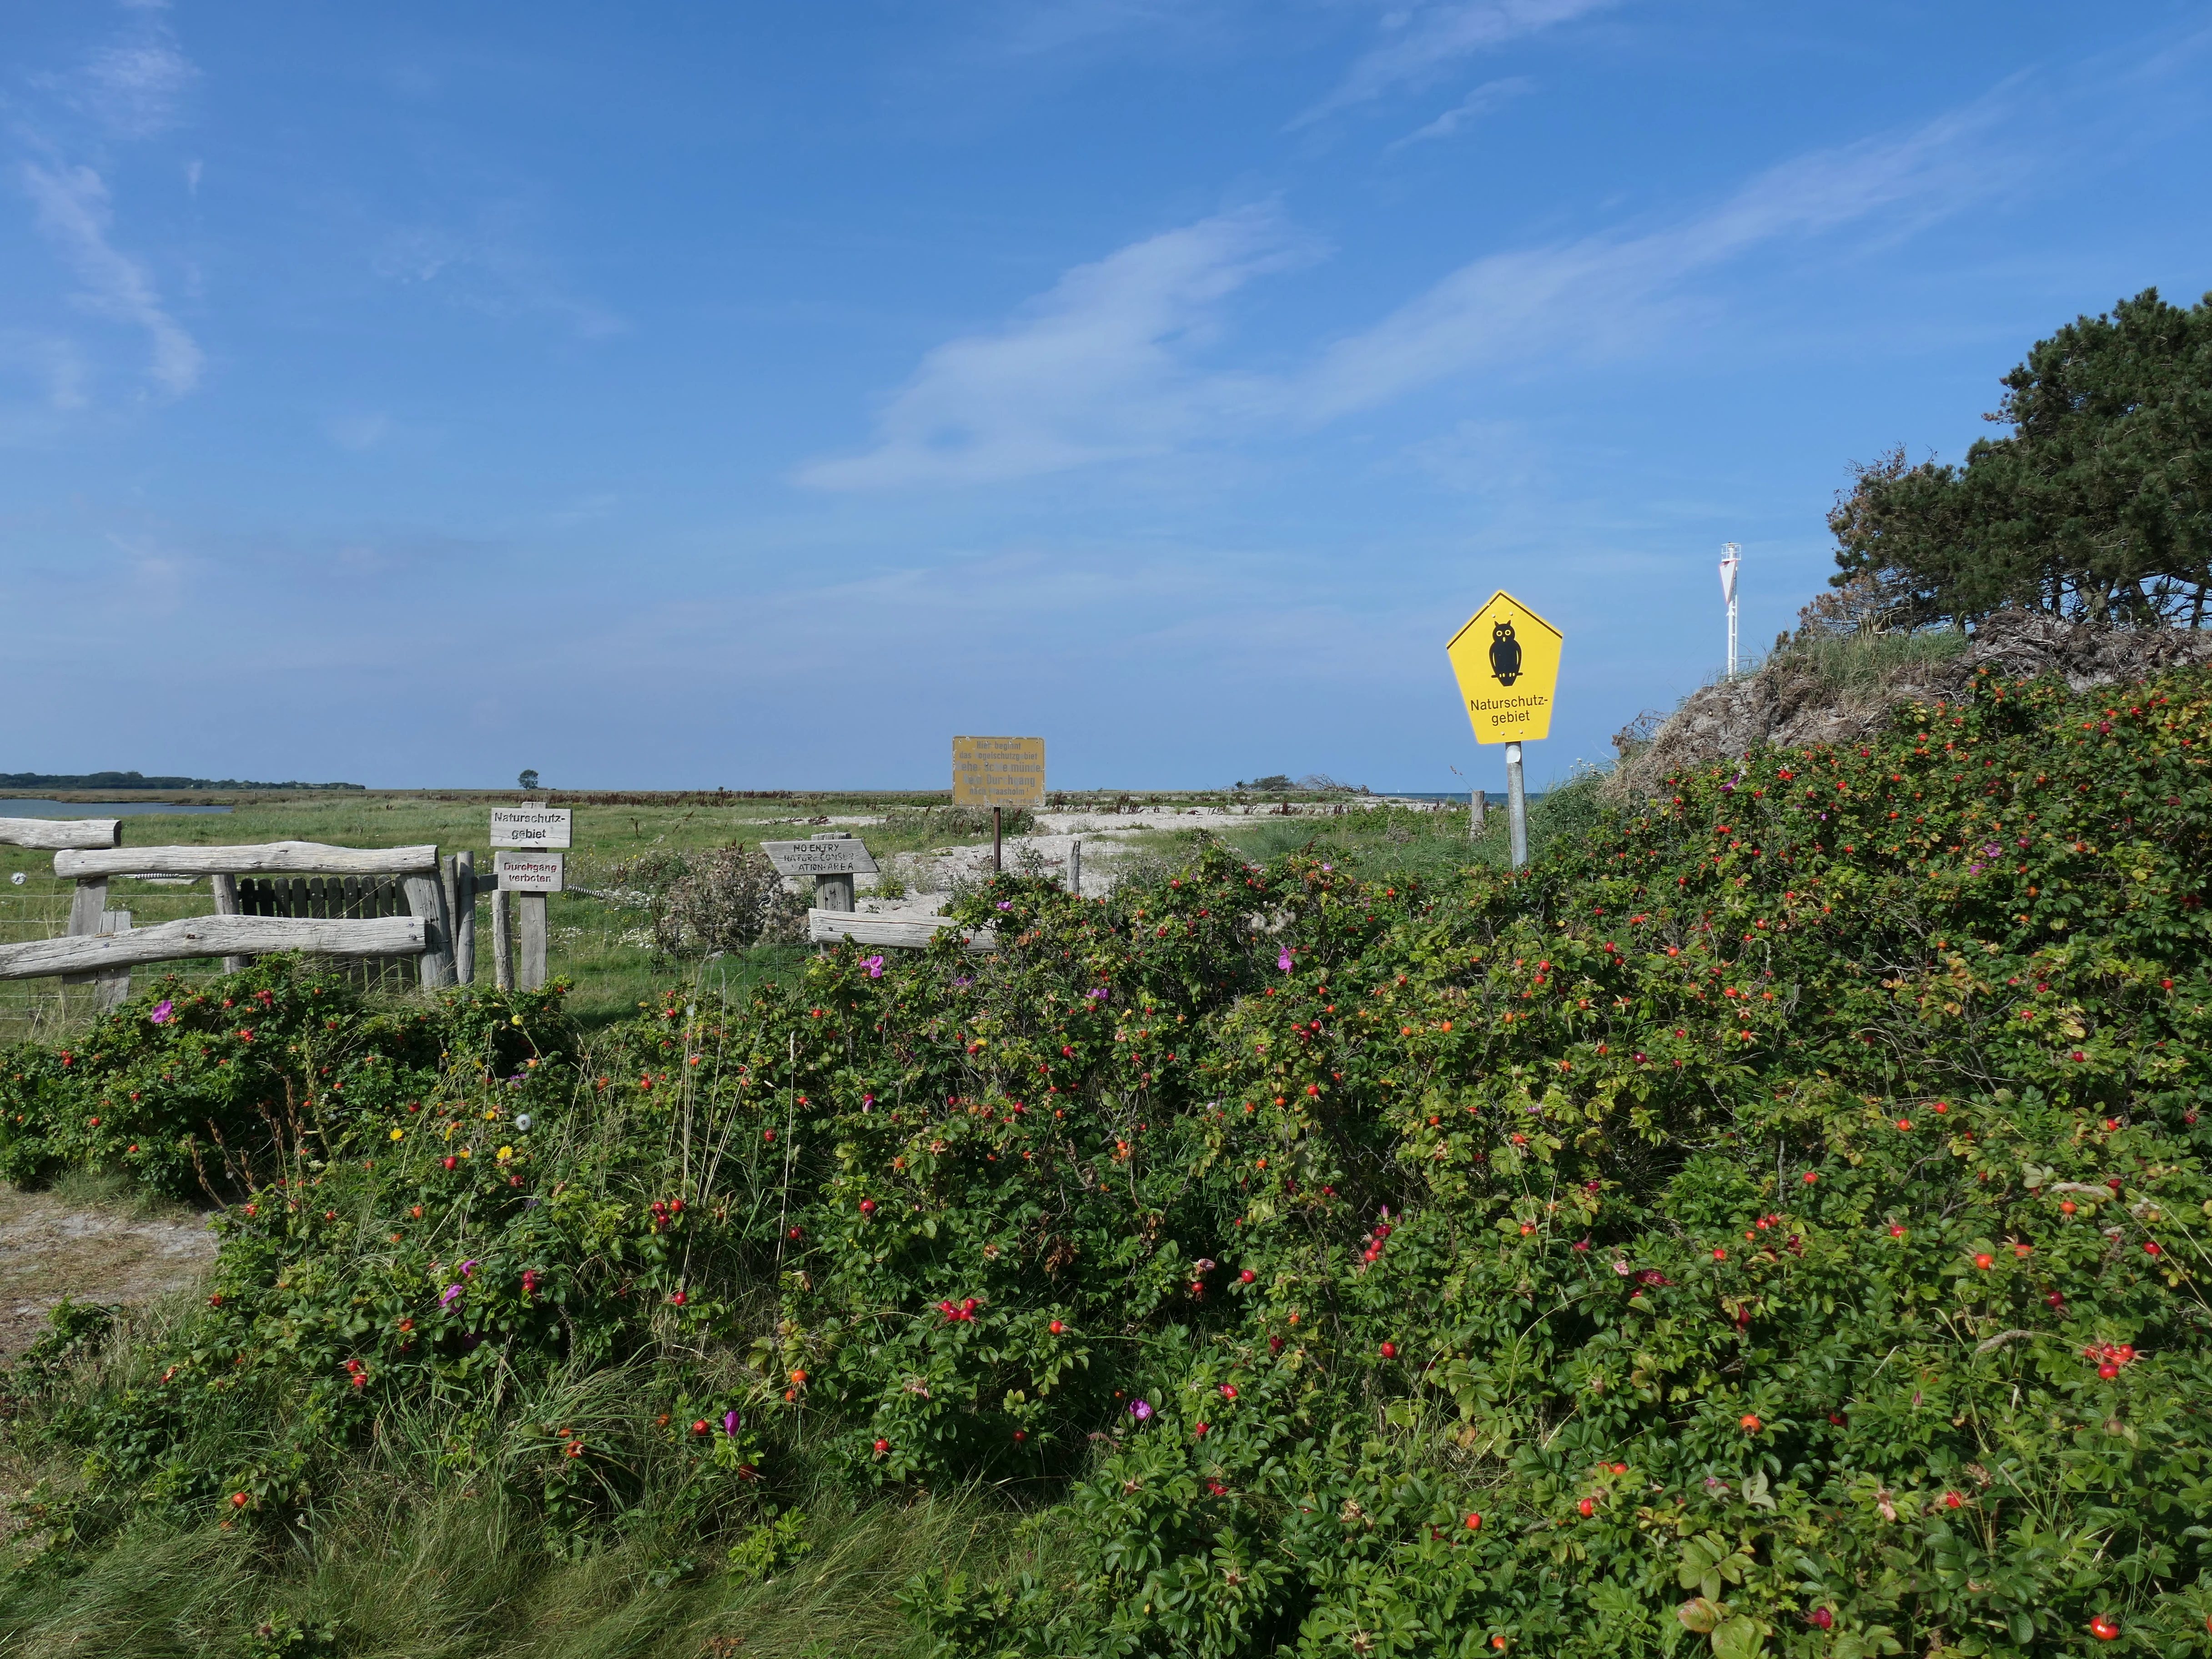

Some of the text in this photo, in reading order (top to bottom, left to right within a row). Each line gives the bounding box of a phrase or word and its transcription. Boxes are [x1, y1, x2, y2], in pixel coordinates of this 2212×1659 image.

[1470, 694, 1548, 711] Naturschutz-
[1491, 710, 1530, 726] gebiet
[977, 741, 1021, 751] Hier beginnt
[987, 774, 1036, 787] Durchgang
[495, 812, 565, 823] Naturschutz-
[512, 829, 546, 840] gebiet
[794, 844, 839, 852] NO ENTRY
[504, 862, 557, 873] Durchgang
[828, 862, 854, 871] AREA
[509, 874, 551, 882] verboten
